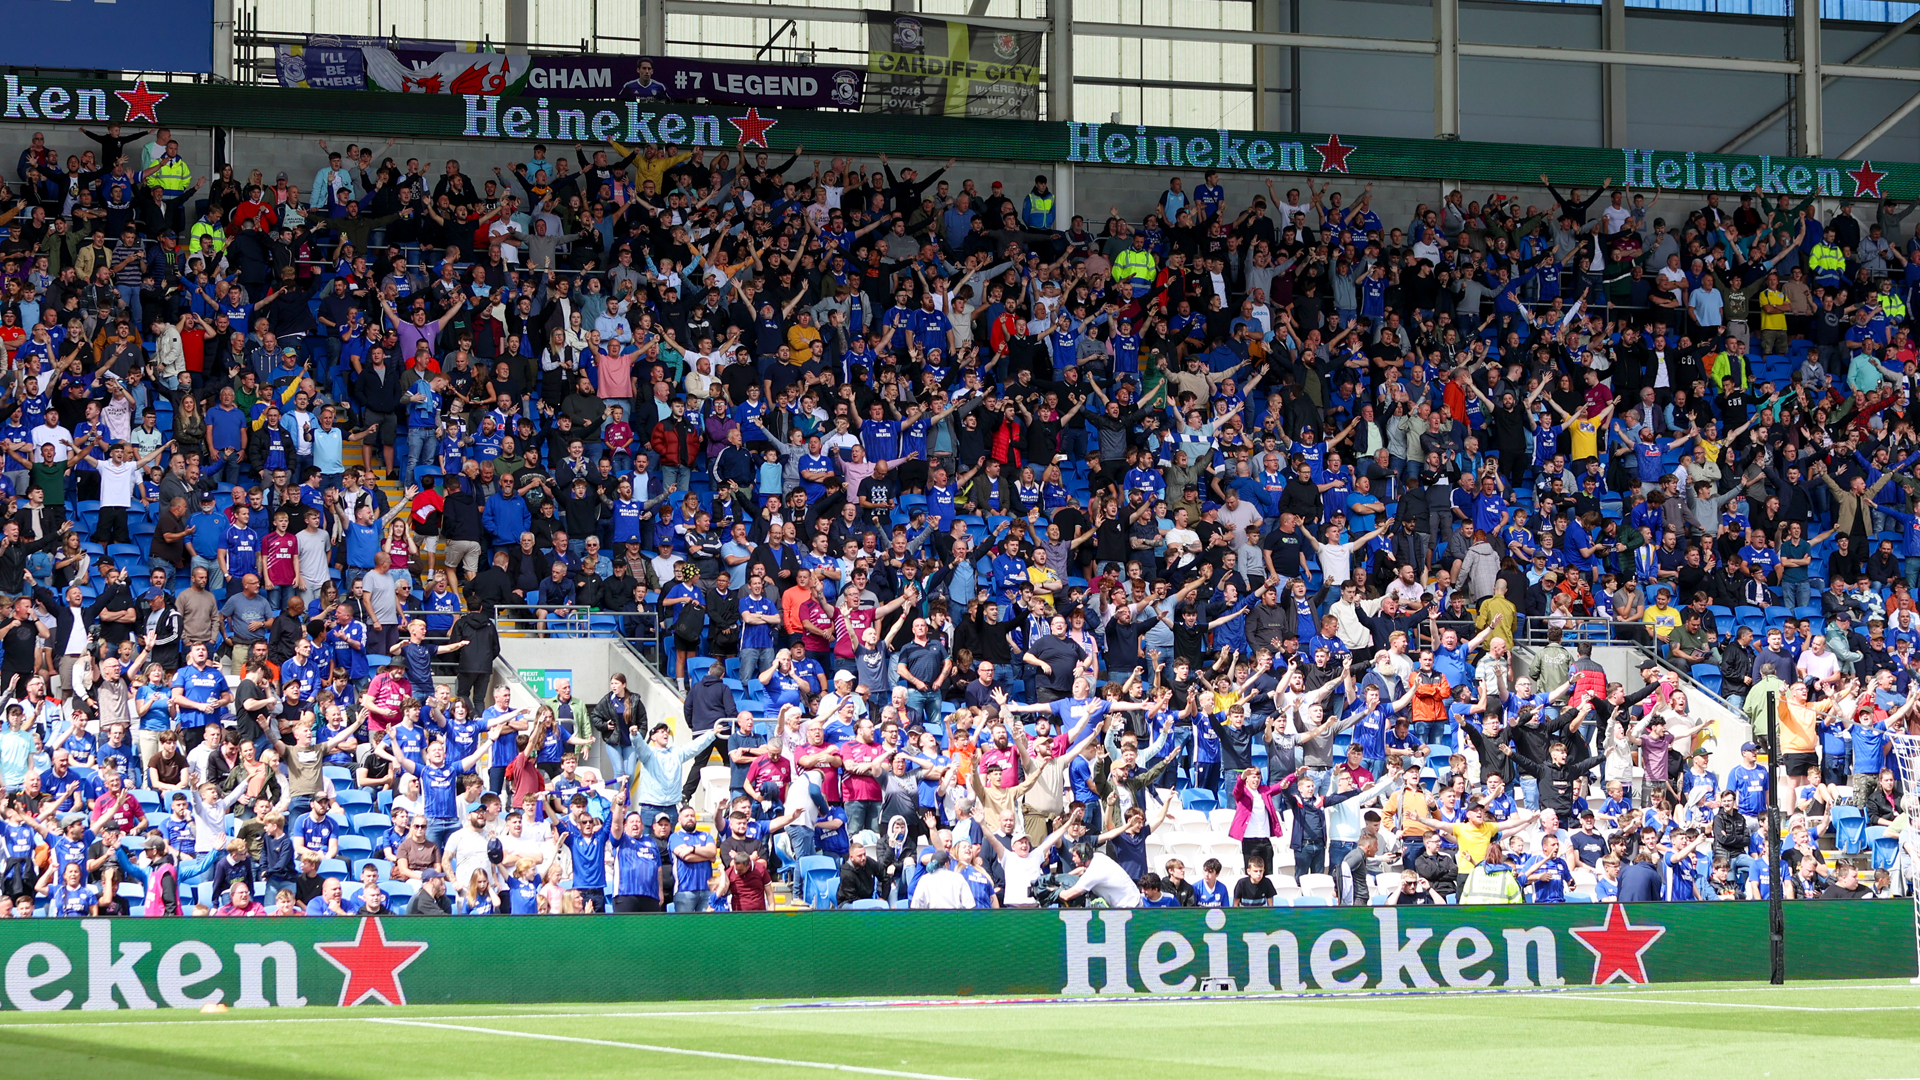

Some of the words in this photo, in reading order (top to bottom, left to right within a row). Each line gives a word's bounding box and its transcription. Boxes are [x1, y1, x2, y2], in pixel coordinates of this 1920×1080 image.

[320, 52, 347, 64] I'LL
[325, 65, 347, 76] BE
[878, 54, 978, 78] CARDIFF
[985, 64, 1033, 82] CITY
[312, 75, 362, 87] THERE
[674, 71, 703, 89] #7
[712, 71, 818, 97] LEGEND
[890, 85, 921, 96] CF46
[3, 74, 111, 121] ken
[881, 98, 927, 109] LOYALS
[987, 95, 1005, 105] WE
[1008, 97, 1023, 107] GO
[462, 94, 723, 147] Heineken
[970, 106, 989, 116] WE
[992, 107, 1038, 120] FOLLOW
[1066, 121, 1308, 171] Heineken
[1621, 148, 1844, 197] Heineken
[1060, 907, 1567, 995] Heineken
[5, 918, 308, 1011] eken
